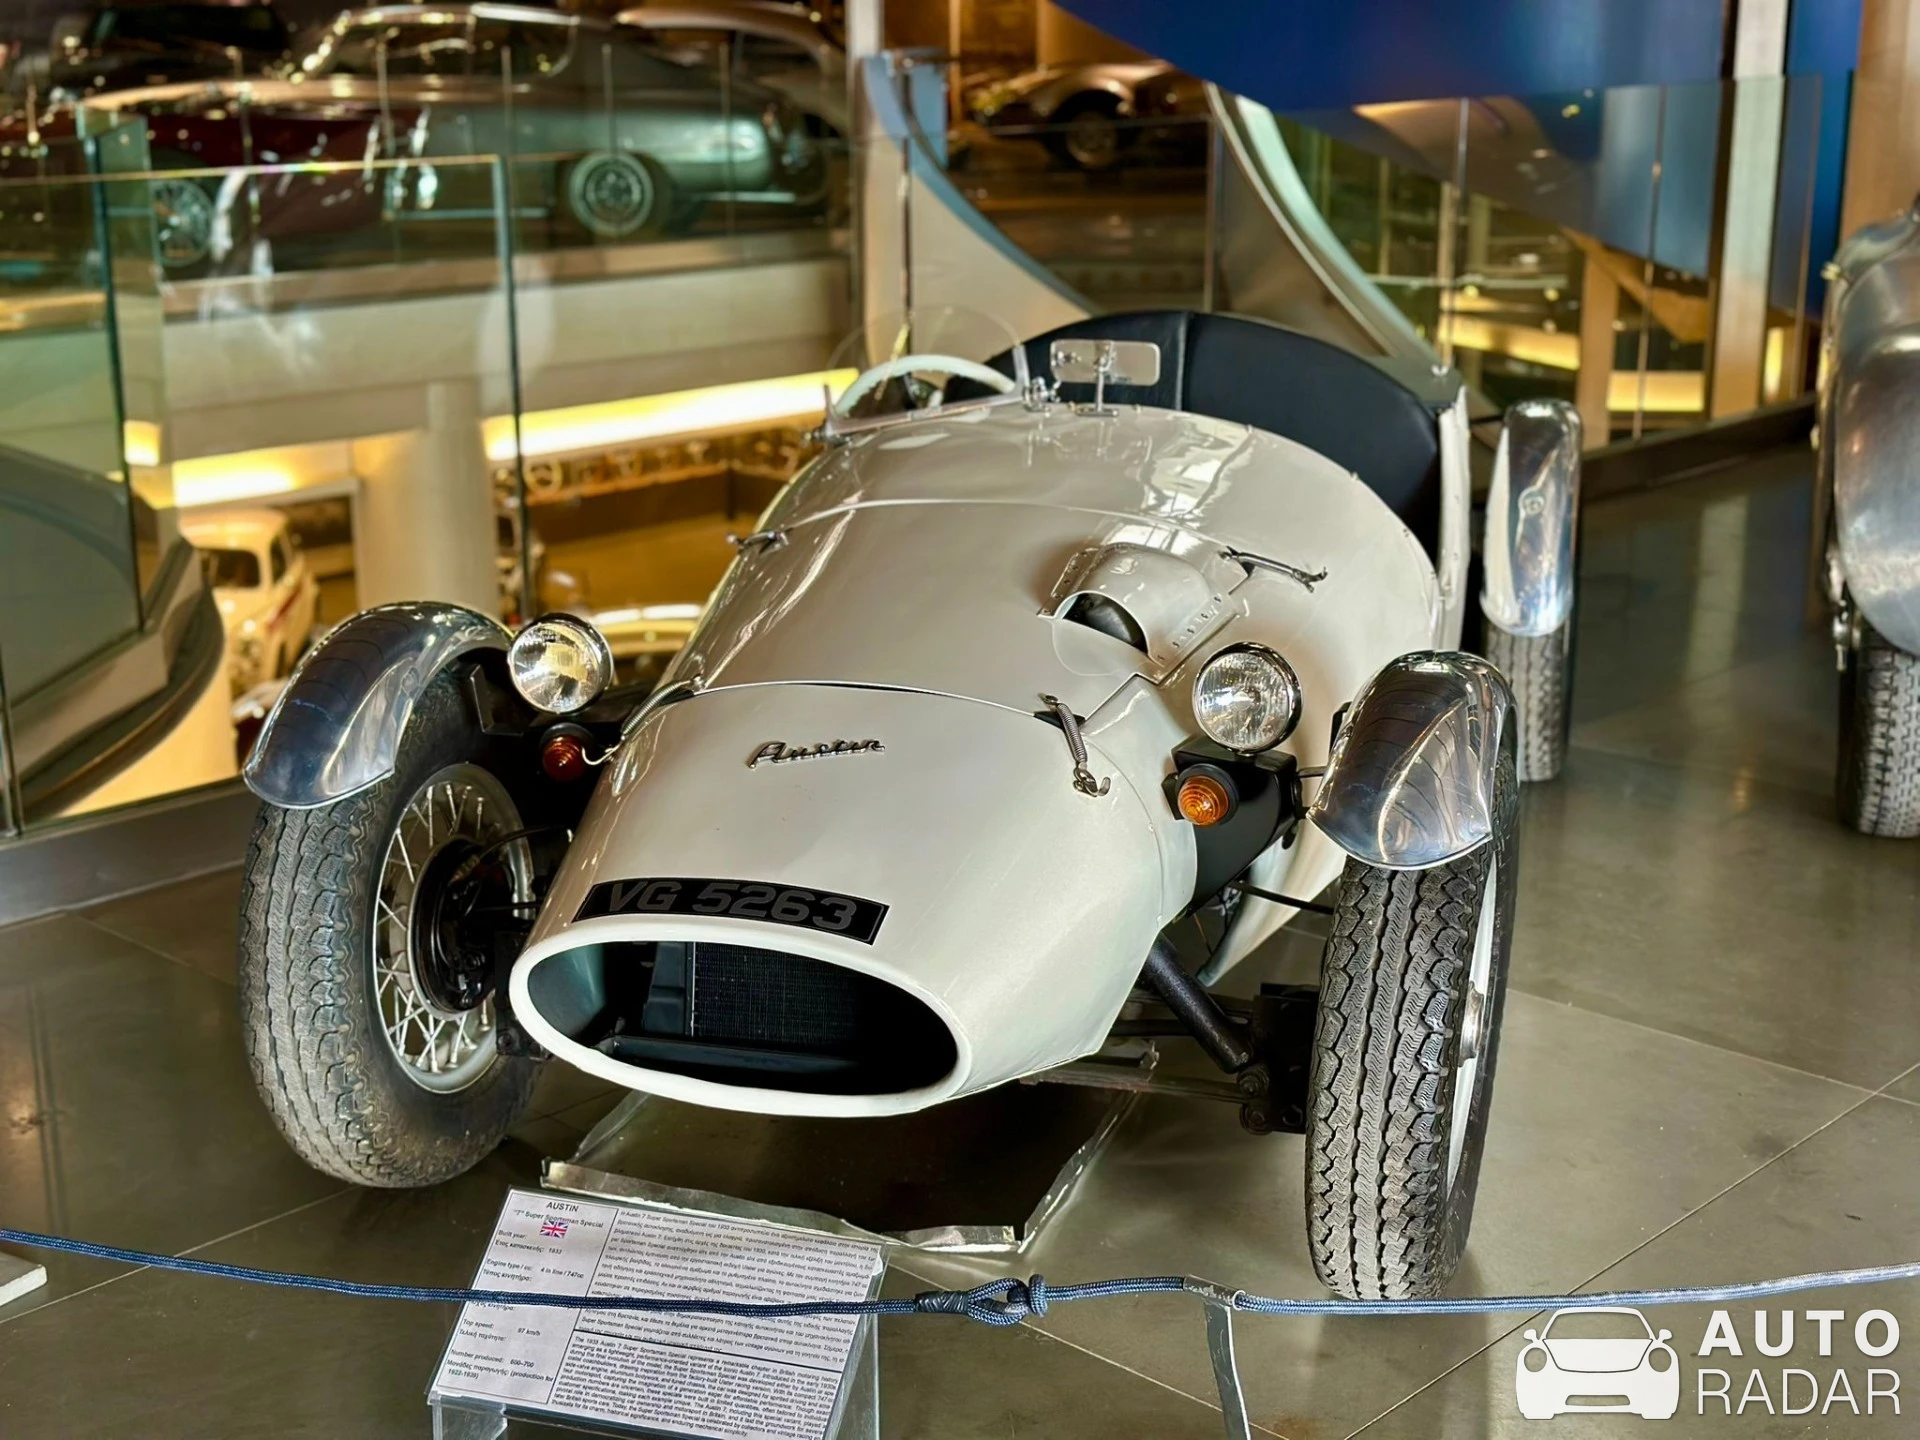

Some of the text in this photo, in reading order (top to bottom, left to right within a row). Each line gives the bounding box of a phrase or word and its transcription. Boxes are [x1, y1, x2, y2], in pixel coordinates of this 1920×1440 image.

[747, 739, 885, 770] Austin
[607, 881, 857, 931] VG 5263
[545, 1201, 579, 1212] AUSTIN
[524, 1211, 544, 1220] Super
[579, 1219, 603, 1229] Special
[511, 1232, 527, 1240] year:
[485, 1259, 506, 1267] Engine
[474, 1320, 494, 1329] speed:
[450, 1349, 474, 1358] Number
[474, 1353, 504, 1363] produced:
[639, 1346, 667, 1355] Sportsman
[667, 1350, 686, 1358] Special
[509, 1370, 544, 1380] (production
